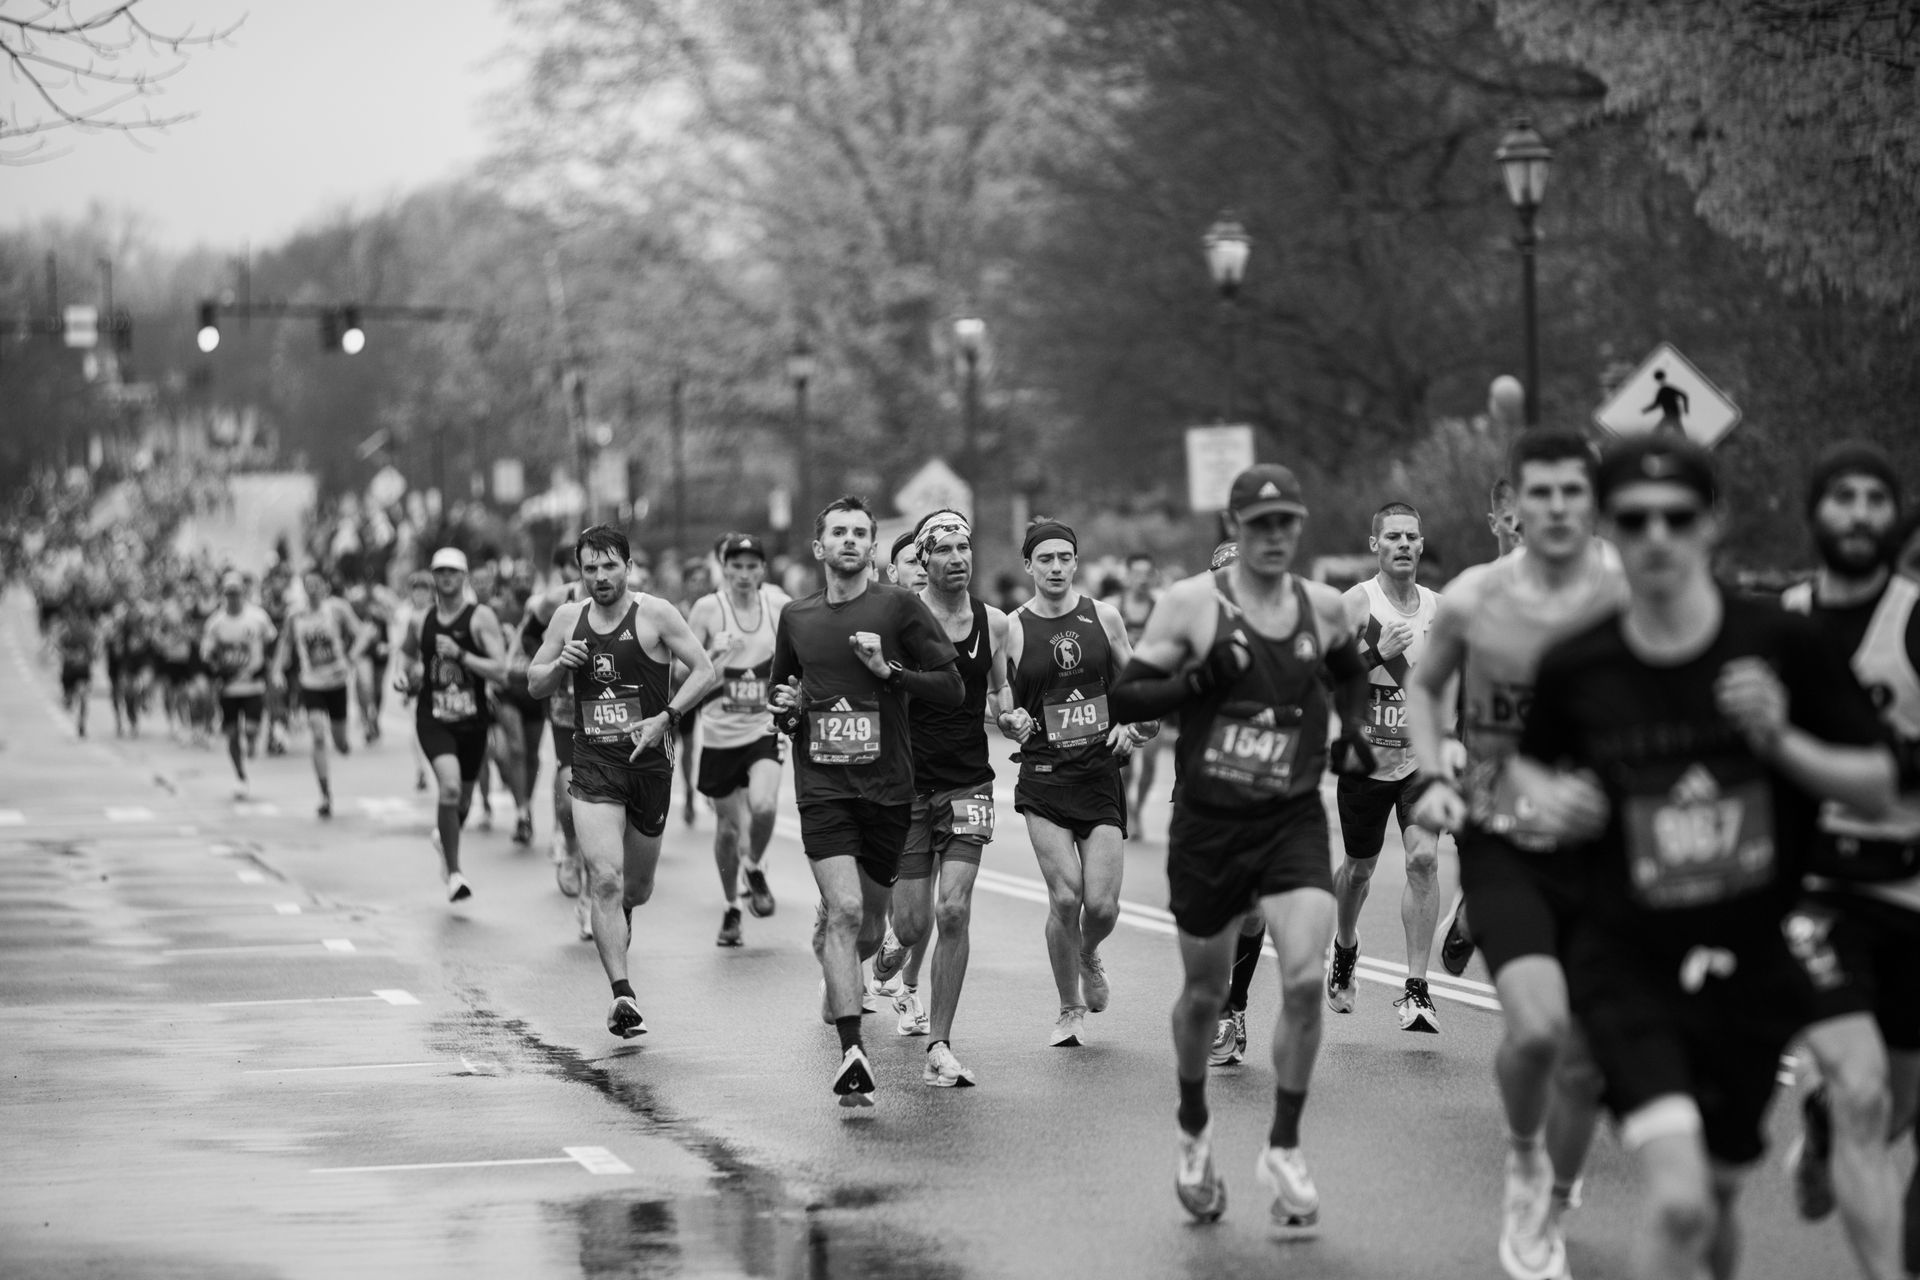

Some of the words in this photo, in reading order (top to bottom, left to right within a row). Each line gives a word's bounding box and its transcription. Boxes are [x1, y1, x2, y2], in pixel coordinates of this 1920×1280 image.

[1049, 632, 1065, 645] BULL
[1065, 630, 1080, 640] CITY
[594, 702, 628, 725] 455
[1058, 703, 1097, 729] 749
[817, 716, 871, 741] 1249
[1222, 723, 1289, 762] 1547
[967, 804, 994, 828] 511
